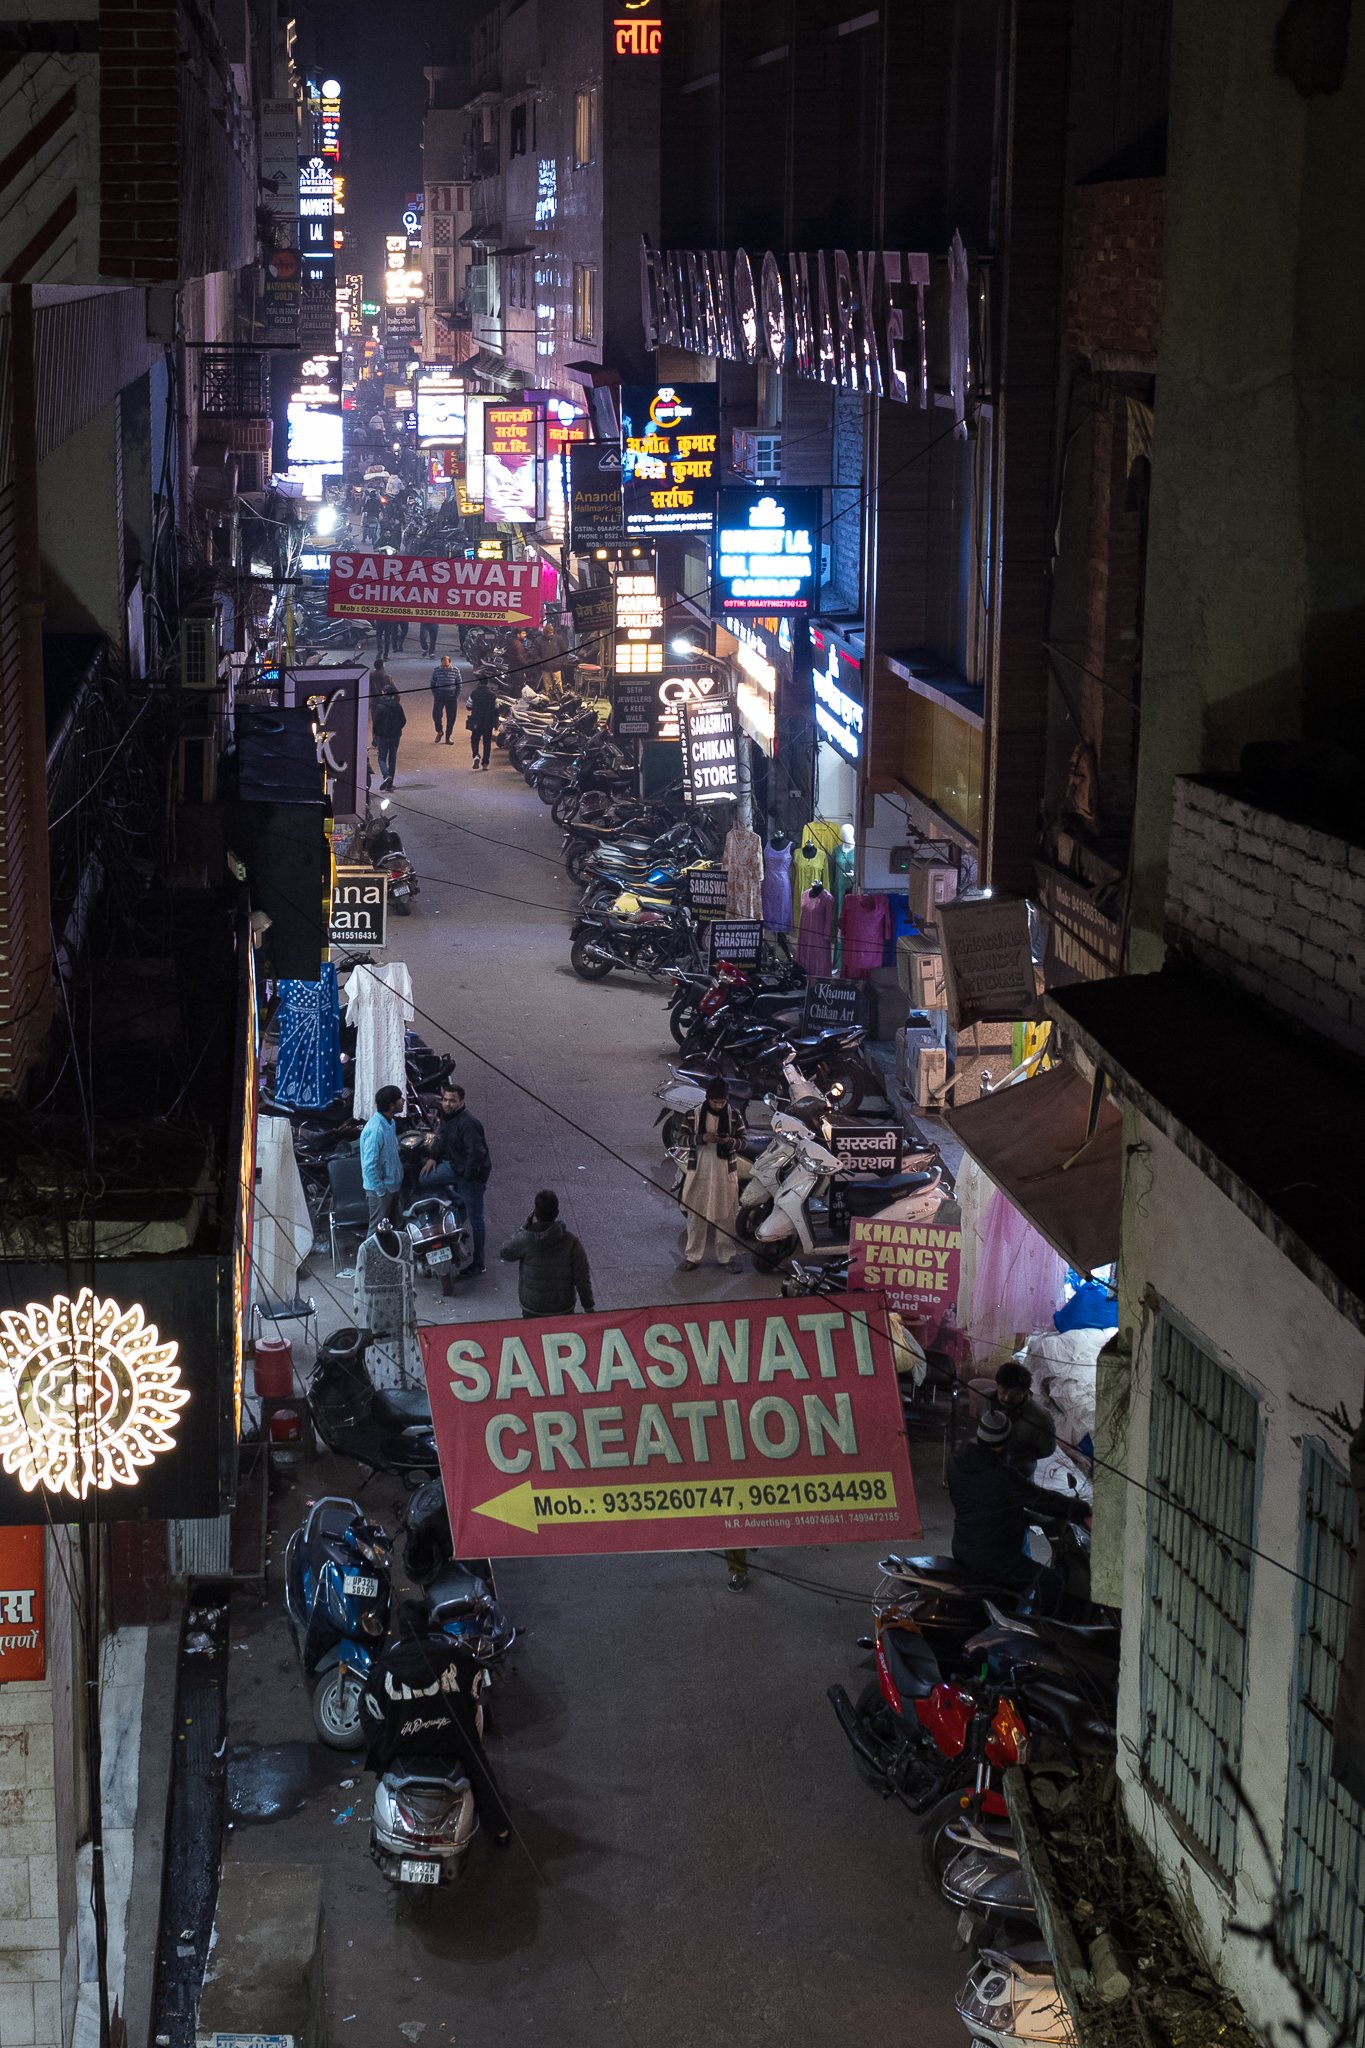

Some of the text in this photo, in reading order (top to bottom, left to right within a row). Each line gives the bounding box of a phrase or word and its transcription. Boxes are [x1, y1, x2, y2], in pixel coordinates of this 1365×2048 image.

[300, 168, 332, 180] NLBK
[300, 198, 333, 216] NAVNEET
[310, 223, 324, 241] LAL
[274, 316, 293, 324] GOLD
[490, 408, 534, 423] लालजी
[676, 435, 716, 457] कुमार
[671, 461, 713, 483] कुमार
[575, 490, 620, 503] Anandi
[334, 555, 540, 589] SARASWATI
[348, 583, 439, 604] CHIKAN
[446, 588, 523, 608] STORE
[340, 604, 355, 612] Mob
[616, 614, 664, 628] JEWELLERS
[627, 686, 643, 694] SETH
[617, 696, 653, 704] JEWELLERS
[690, 713, 733, 736] SARASWATI
[679, 711, 688, 776] SARASWATI
[691, 738, 736, 762] CHIKAN
[694, 765, 737, 788] STORE
[689, 879, 727, 895] SARASWA
[692, 895, 712, 904] CHIKAN
[714, 931, 760, 948] SARASWATI
[716, 948, 737, 958] CHIKAN
[738, 948, 757, 958] STORE
[815, 983, 857, 1006] Khanna
[810, 1003, 839, 1020] Chikan
[840, 1007, 855, 1022] Art
[836, 1131, 898, 1150] सरस्वती
[854, 1222, 962, 1250] KHANNA
[865, 1244, 951, 1270] FANCY
[863, 1265, 950, 1291] STORE
[878, 1289, 942, 1304] holesale
[892, 1300, 919, 1311] And
[445, 1309, 876, 1403] SARASWATI
[484, 1391, 859, 1475] CREATION
[532, 1478, 888, 1517] Mob.: 9335260747, 9621634498
[725, 1519, 742, 1529] N.R.
[352, 1586, 375, 1596] S8297
[0, 1589, 36, 1625] स
